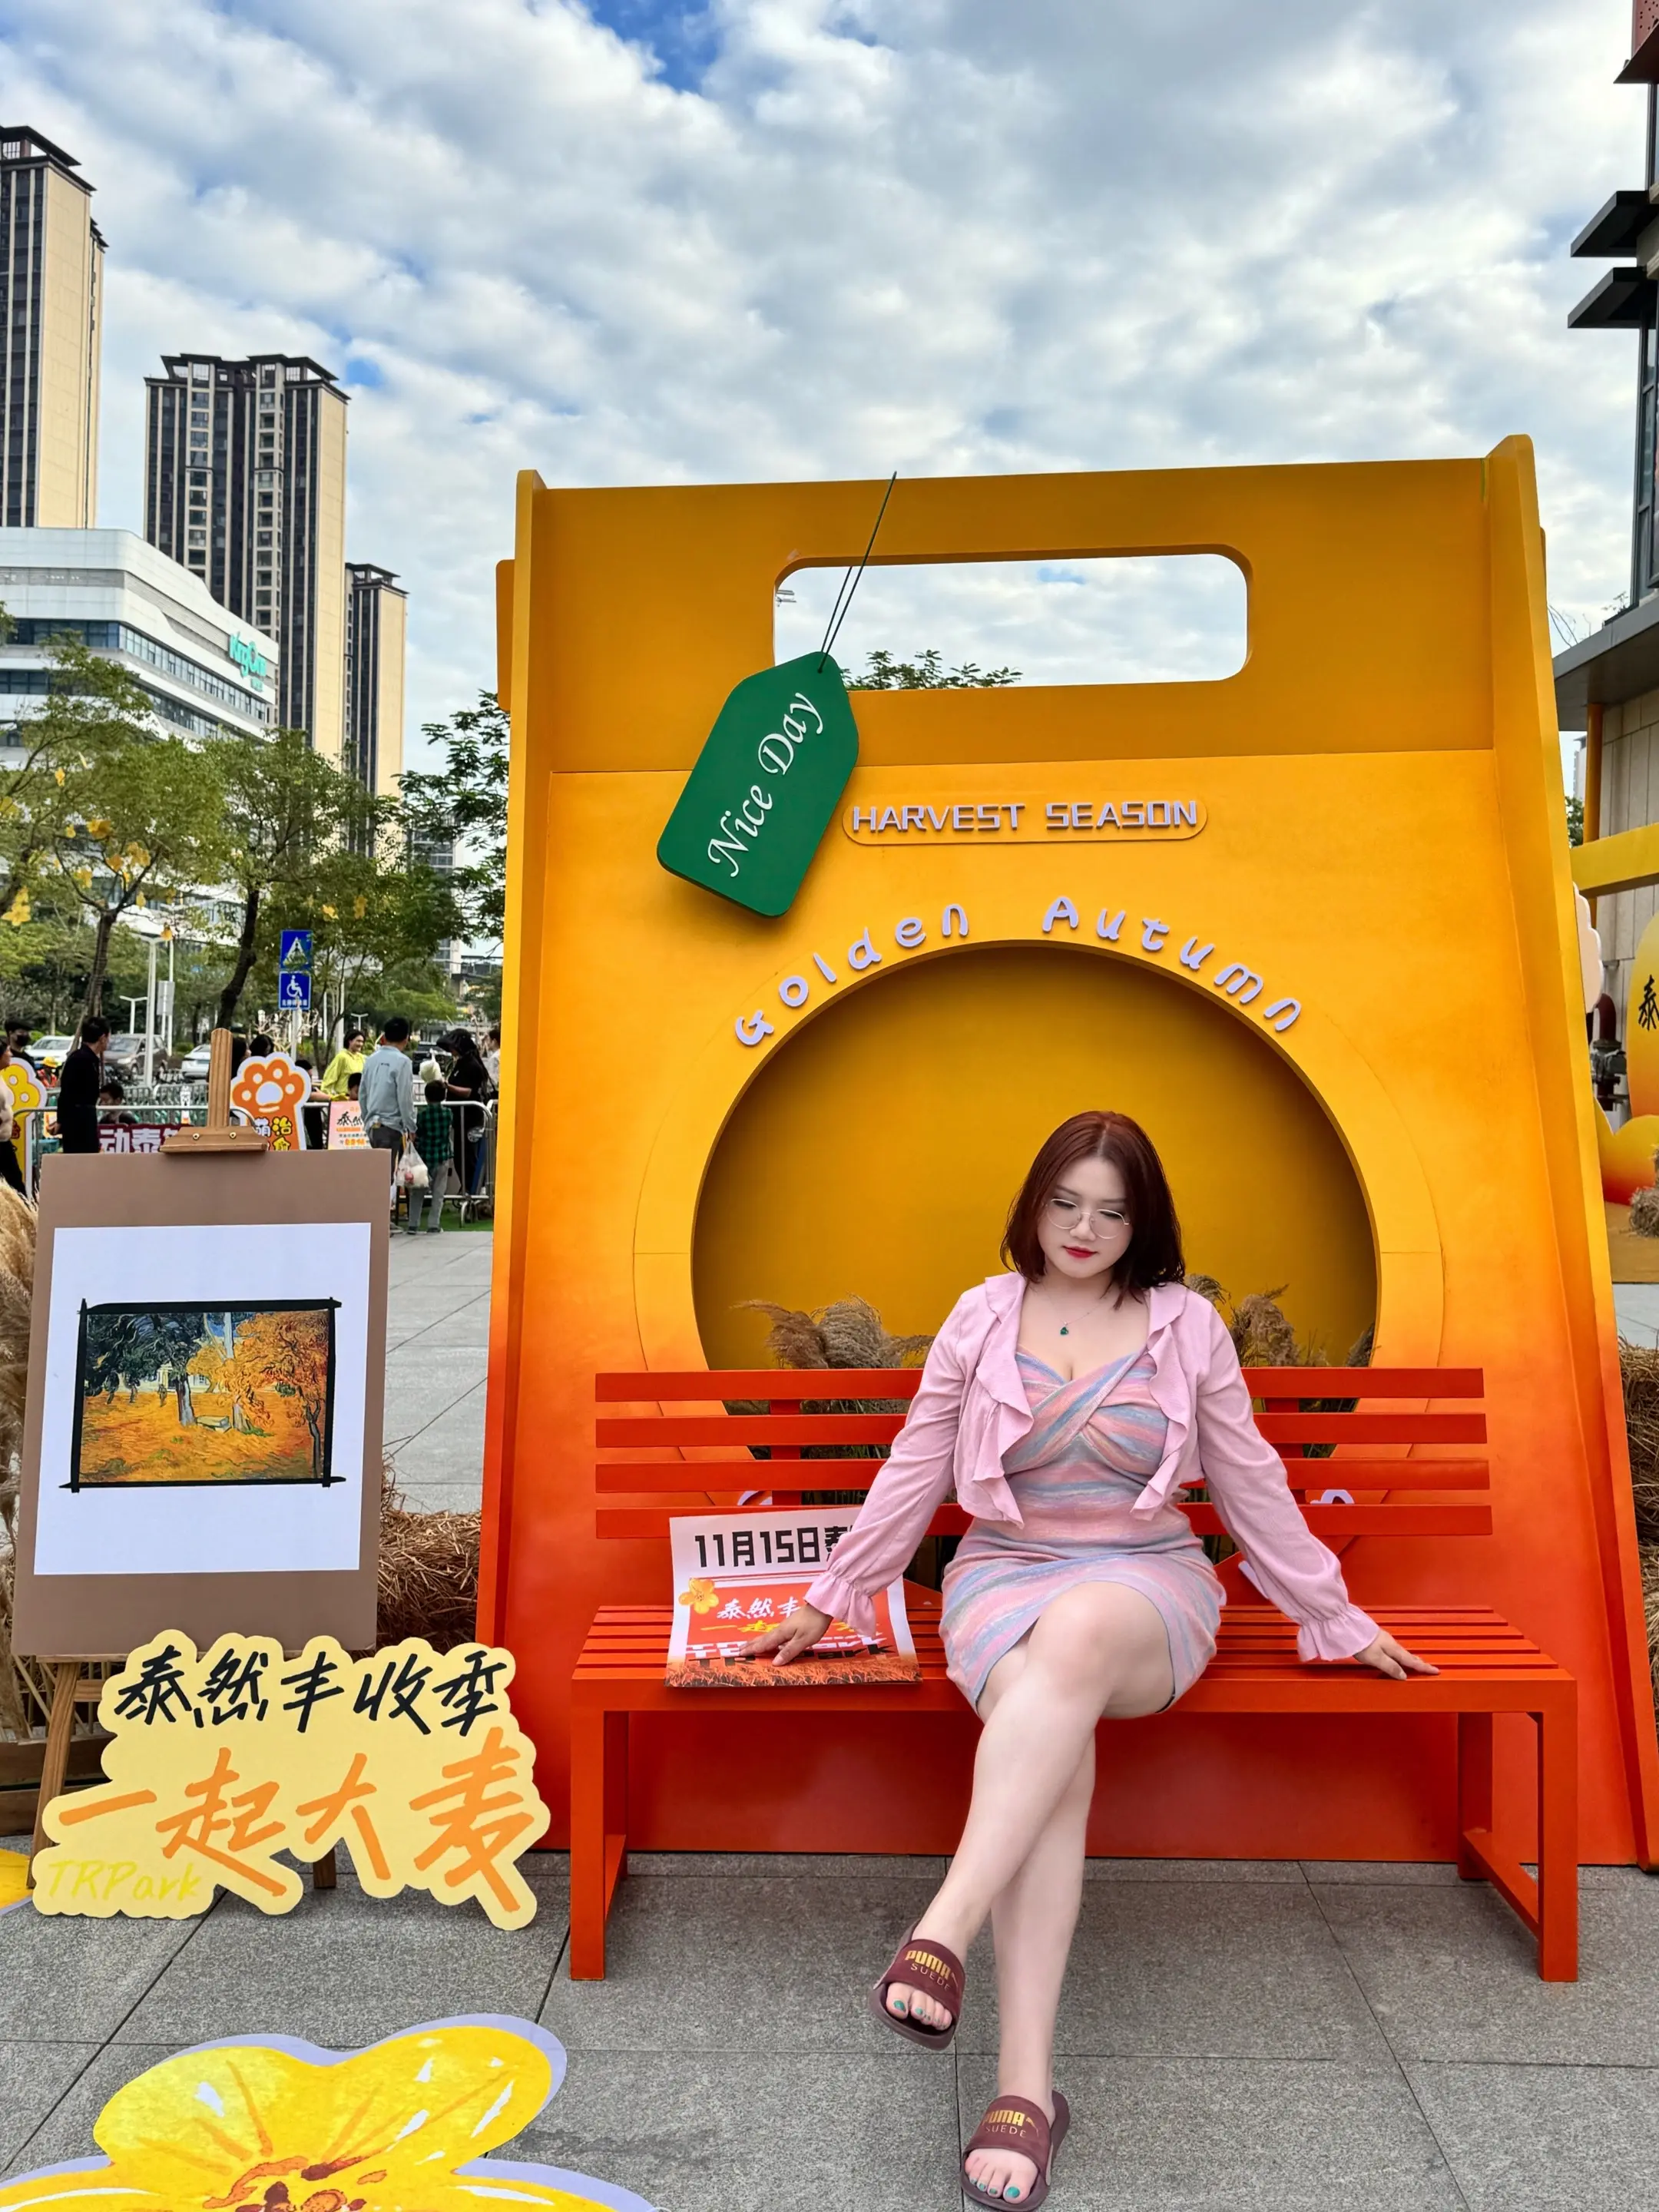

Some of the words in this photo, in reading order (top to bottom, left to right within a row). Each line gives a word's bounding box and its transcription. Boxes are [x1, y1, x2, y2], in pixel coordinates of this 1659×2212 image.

[707, 785, 773, 877] Nice
[758, 693, 823, 775] Day
[853, 803, 1025, 833] HARVEST
[1046, 800, 1197, 830] SEASON
[734, 903, 969, 1046] Golden
[1042, 896, 1302, 1031] Autumn
[99, 1128, 179, 1153] 动泰
[695, 1525, 853, 1568] 11月15日
[114, 1644, 508, 1737] 泰然丰收季
[48, 1859, 201, 1901] TRPark
[905, 1950, 952, 1980] PUMA
[910, 1963, 951, 1992] SUEDE
[982, 2110, 1025, 2127] PUMA
[985, 2124, 1027, 2138] SUEDE
